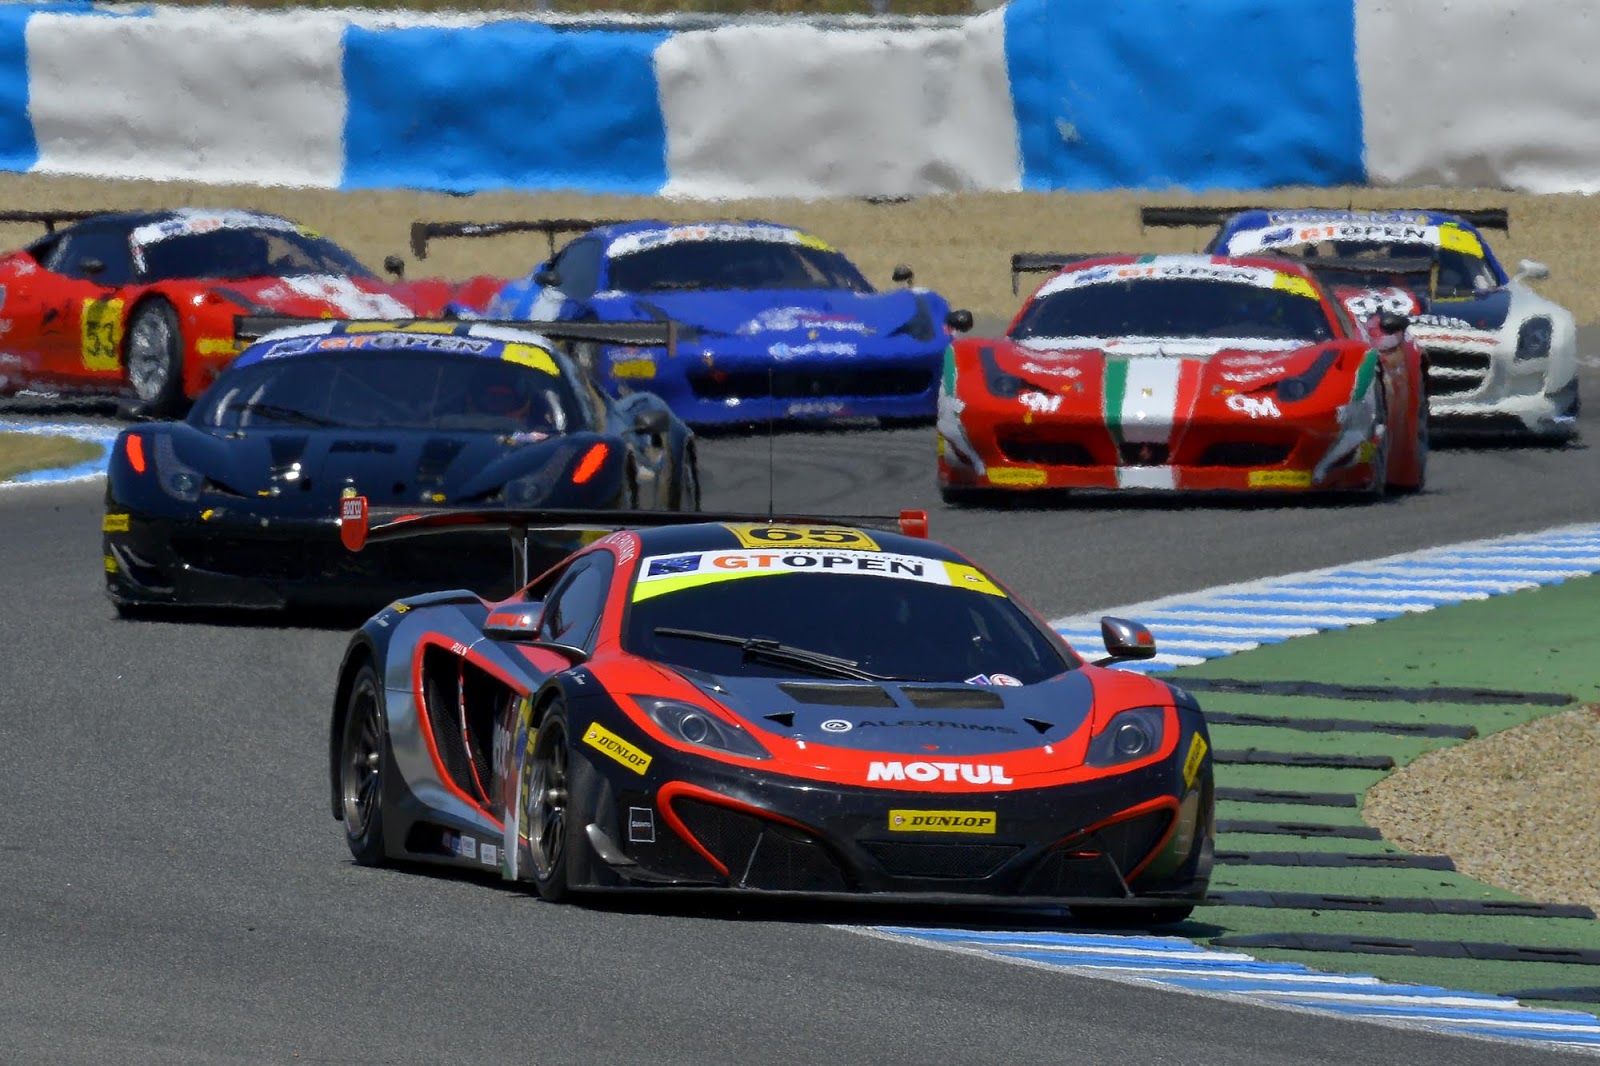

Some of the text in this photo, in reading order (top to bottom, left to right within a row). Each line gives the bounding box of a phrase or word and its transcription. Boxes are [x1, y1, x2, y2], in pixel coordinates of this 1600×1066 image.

[86, 321, 117, 358] 53
[749, 527, 861, 543] 65
[785, 551, 926, 565] INTERNATIONAL
[856, 720, 1018, 735] ALEXRIMS
[596, 736, 647, 767] DUNLOP
[866, 761, 1014, 785] MOTUL
[910, 815, 993, 828] DUNLOP
